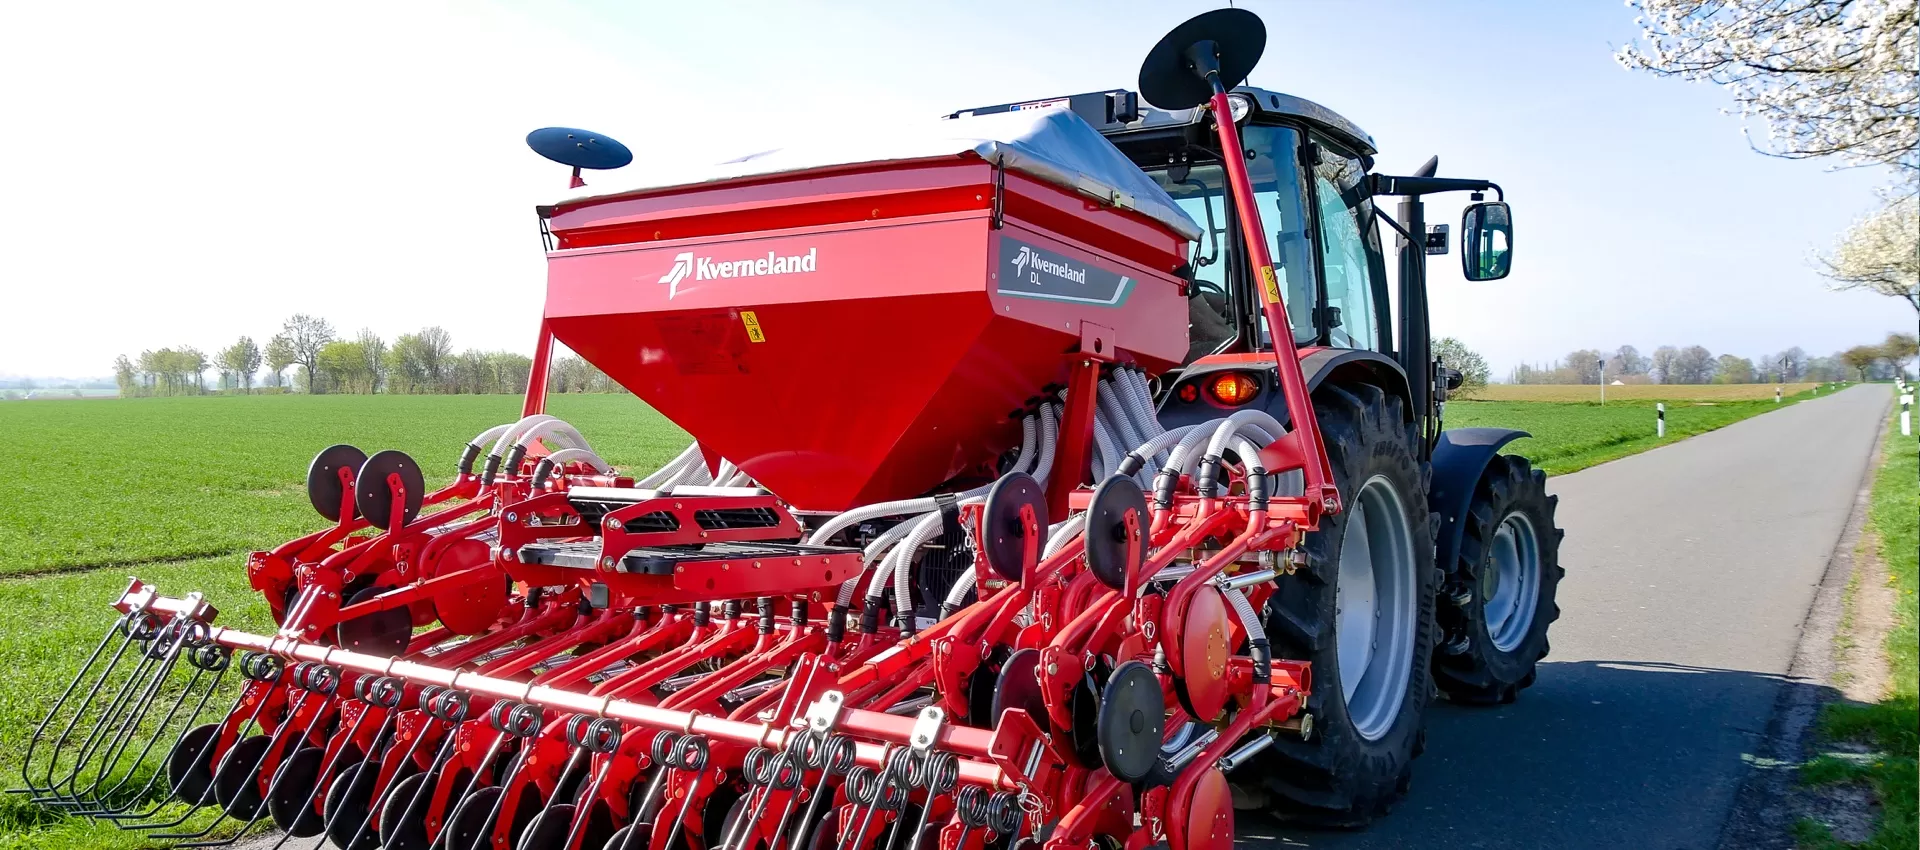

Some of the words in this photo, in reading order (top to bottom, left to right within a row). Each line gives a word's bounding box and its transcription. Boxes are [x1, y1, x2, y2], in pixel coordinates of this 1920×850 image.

[696, 248, 817, 281] Kverneland
[1030, 271, 1041, 286] DL
[1031, 251, 1086, 285] Kverneland
